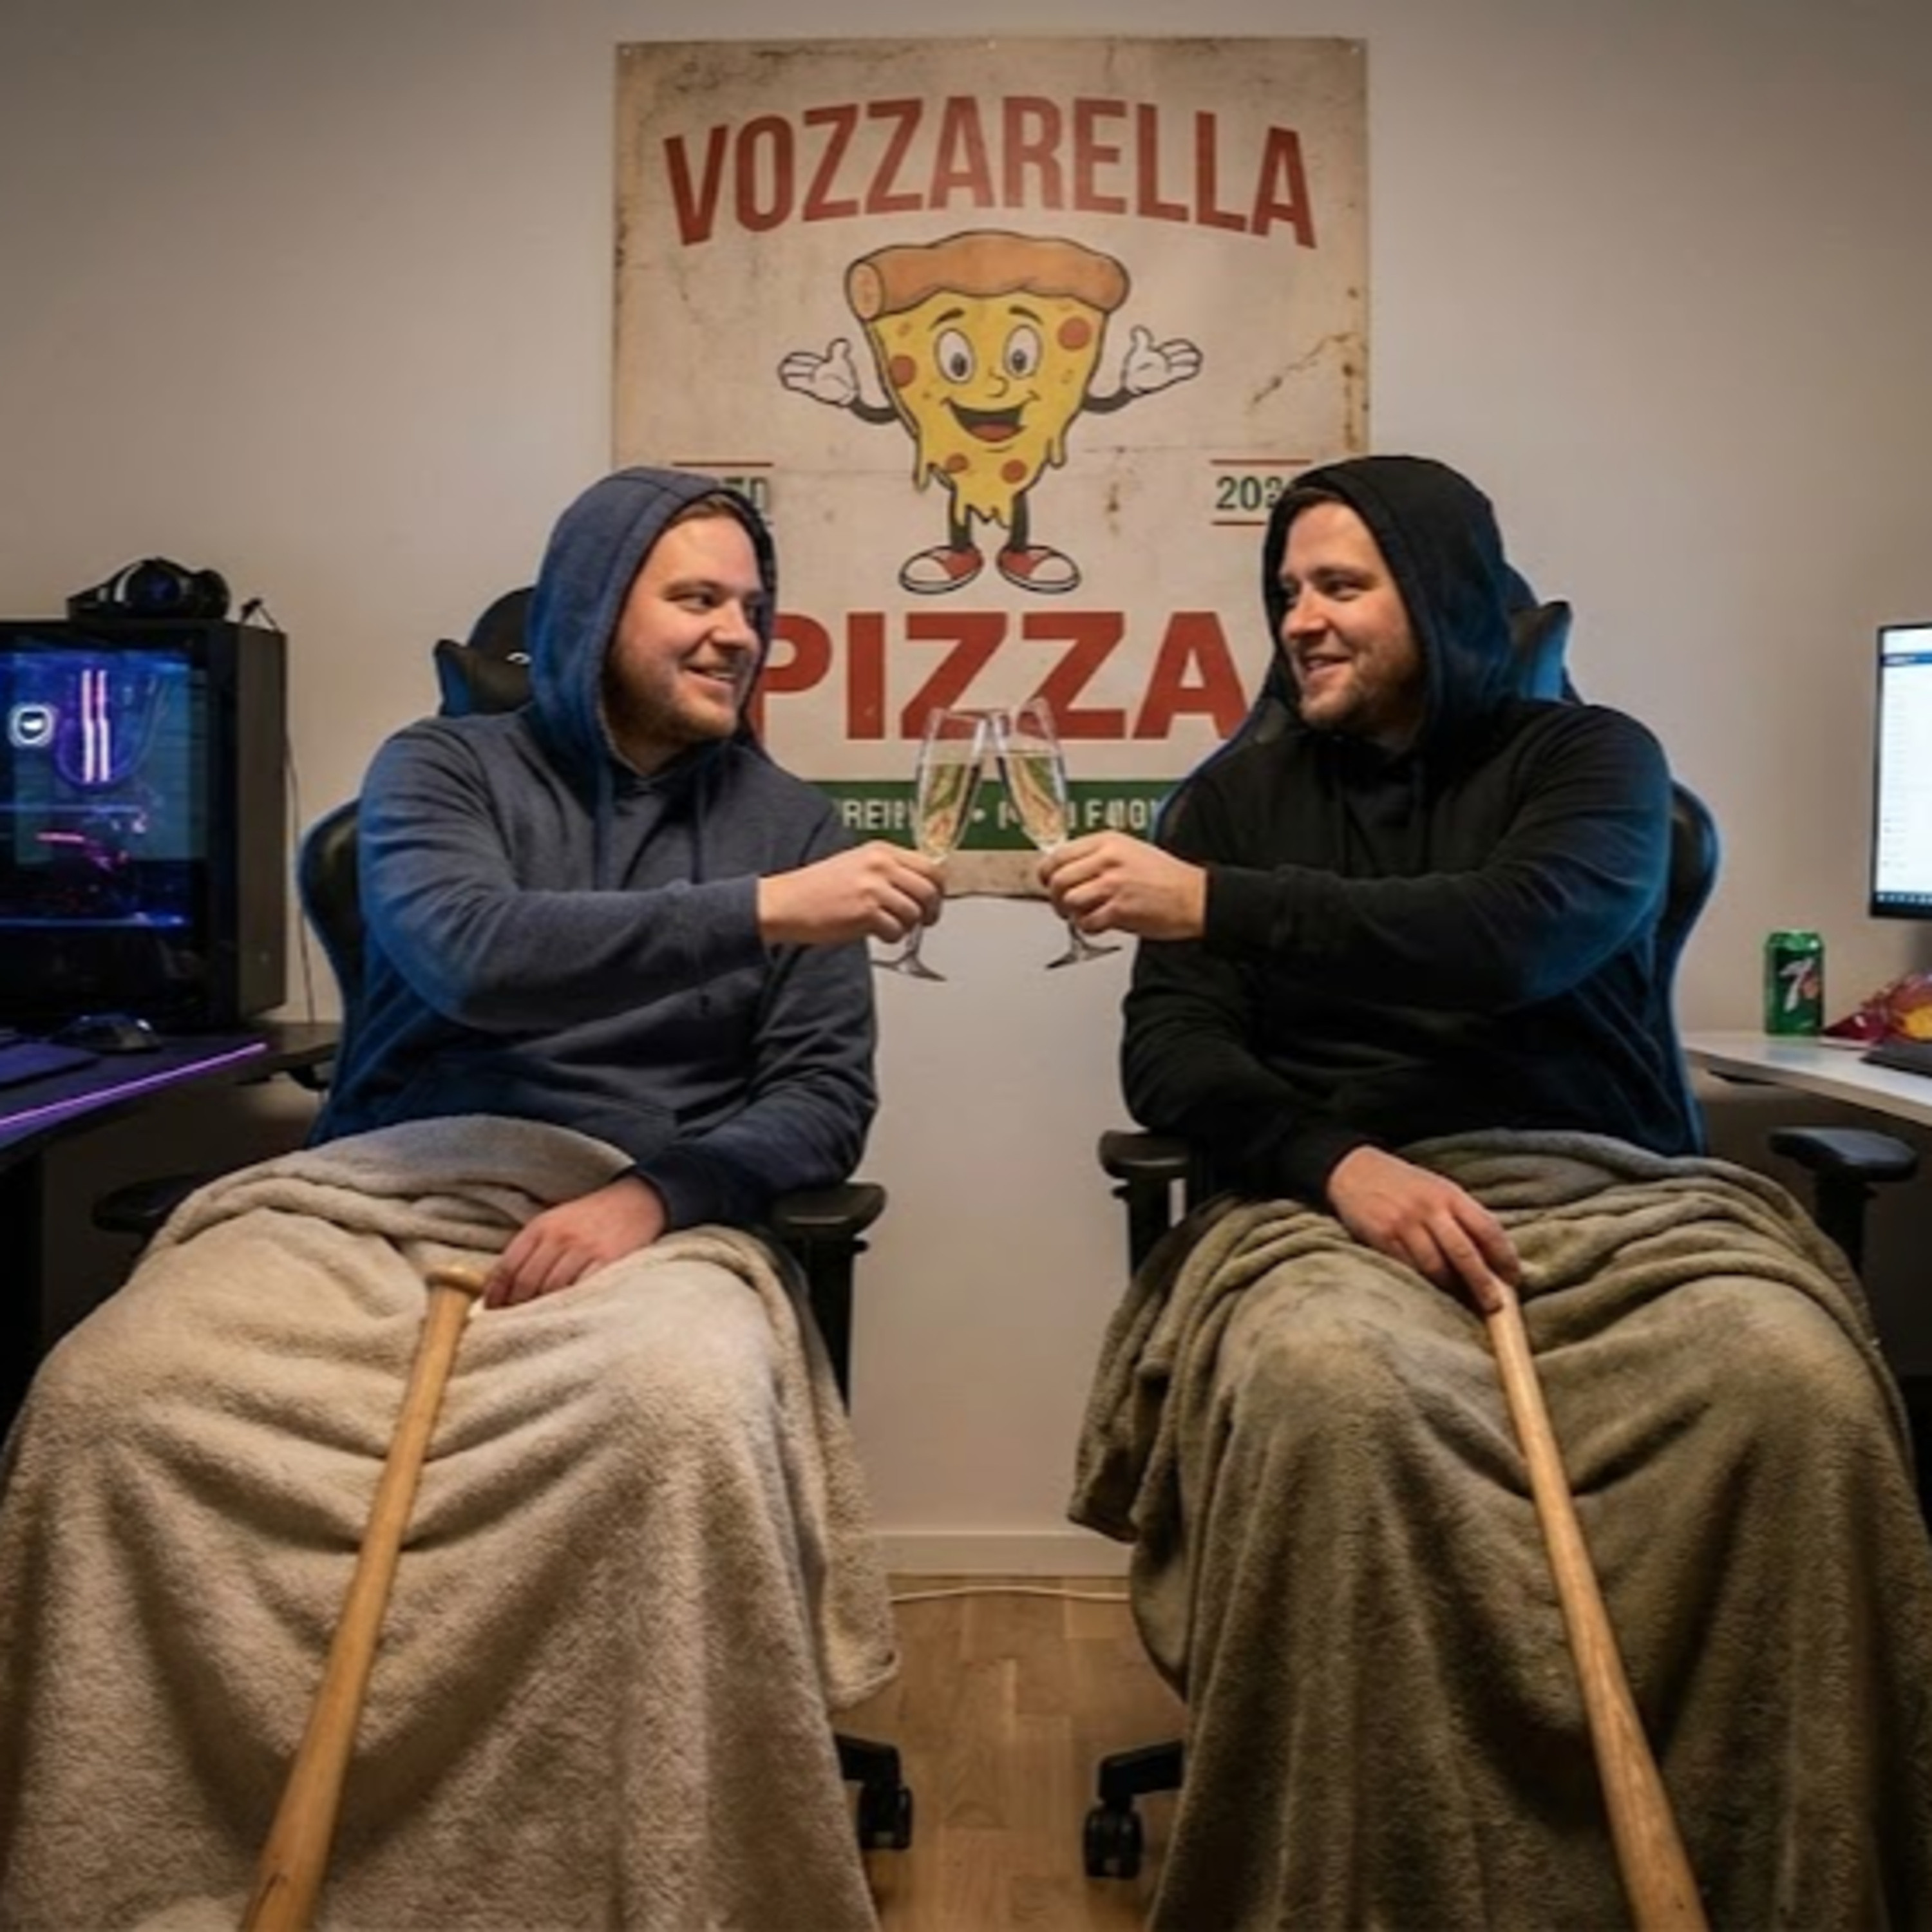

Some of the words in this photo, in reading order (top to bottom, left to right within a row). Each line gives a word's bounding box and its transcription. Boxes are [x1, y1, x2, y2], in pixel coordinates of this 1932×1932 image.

[663, 95, 1317, 249] VOZZARELLA
[1215, 476, 1283, 511] 202
[752, 611, 1249, 740] PIZZA
